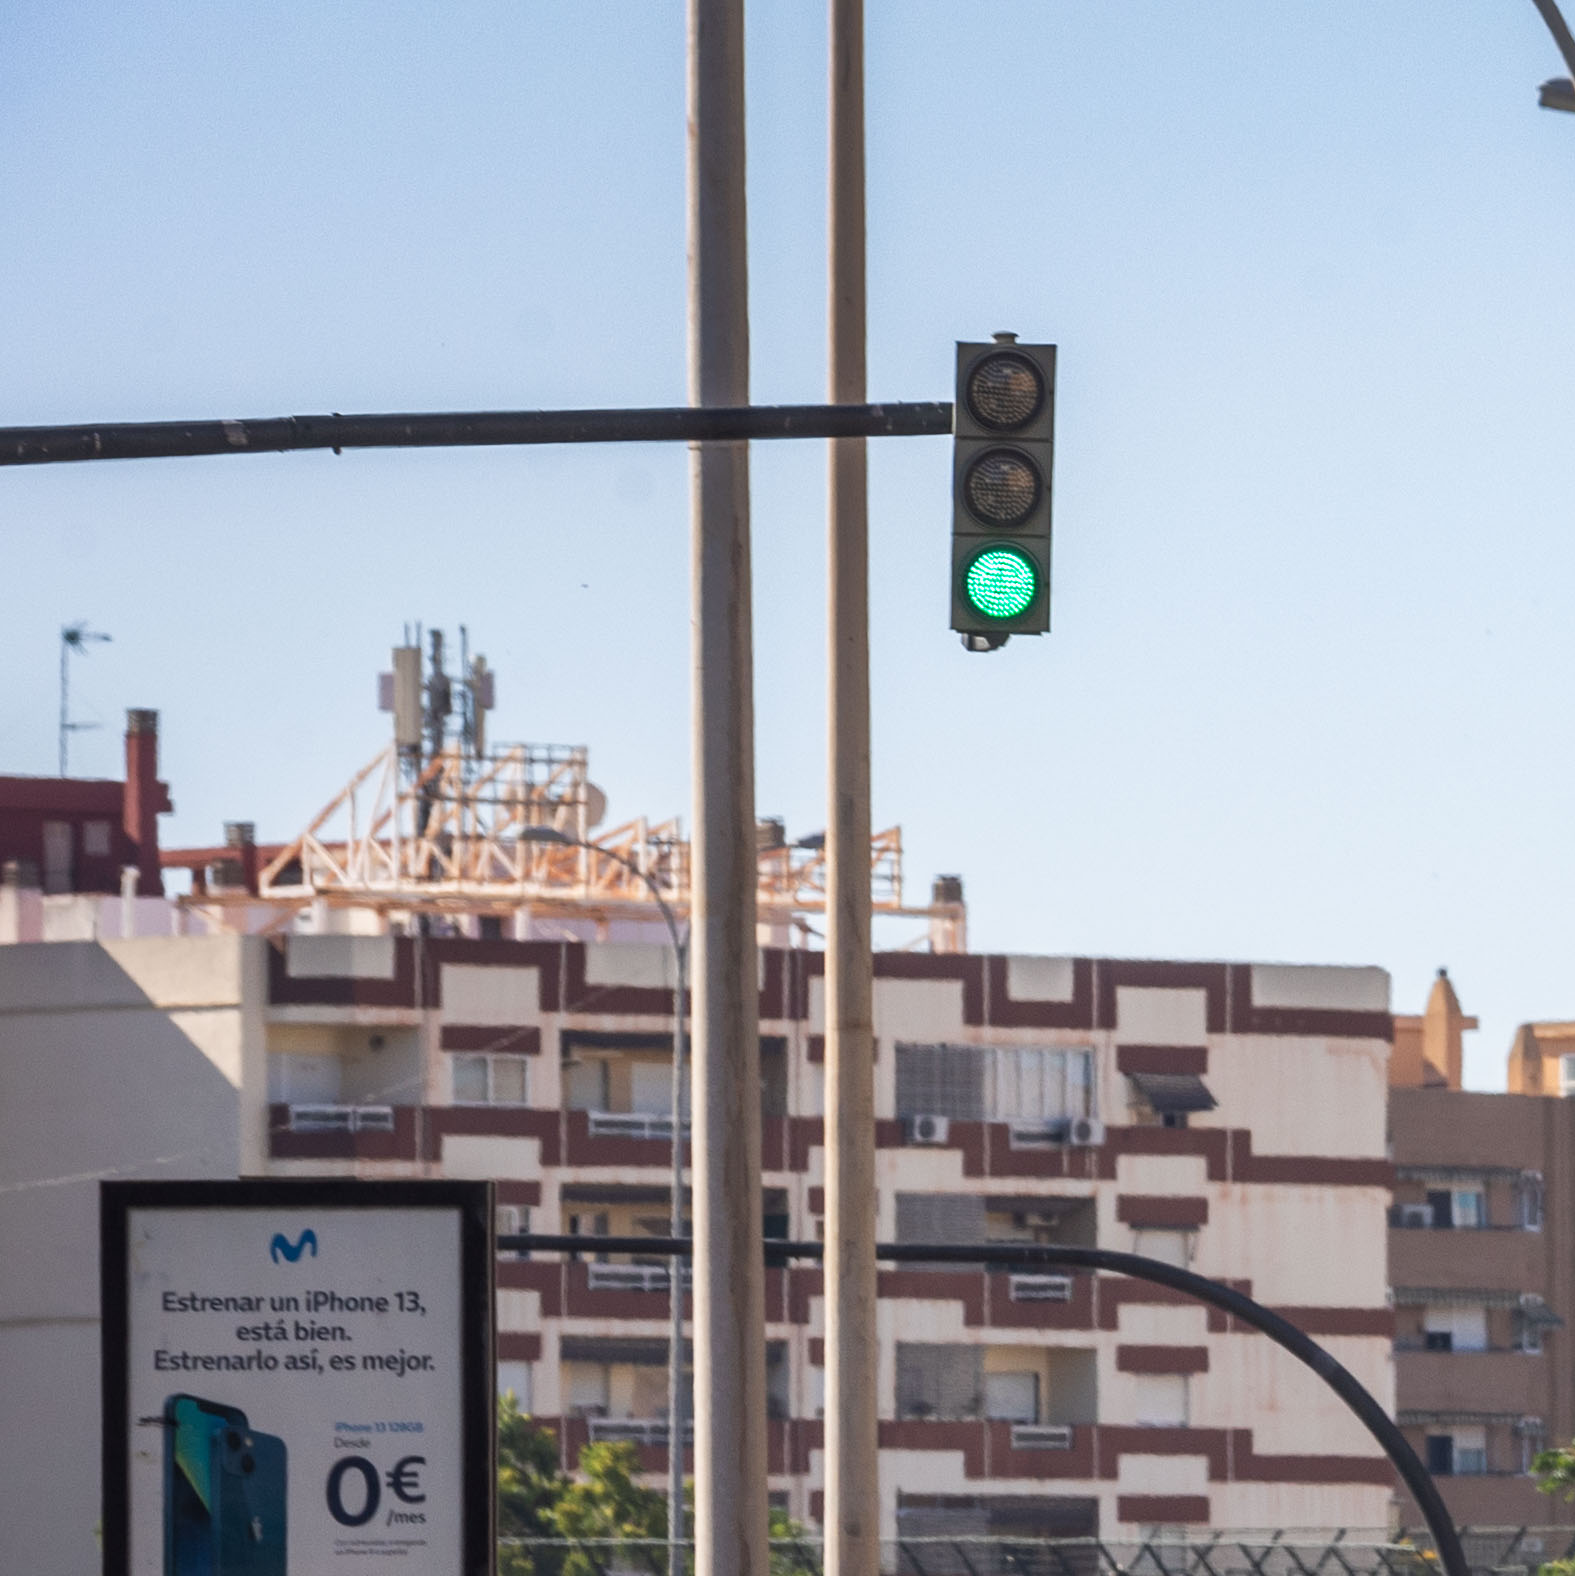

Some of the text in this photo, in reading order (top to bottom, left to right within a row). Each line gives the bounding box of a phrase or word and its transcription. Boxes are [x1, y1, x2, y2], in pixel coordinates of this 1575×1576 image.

[162, 1290, 426, 1316] Estrenar un iPhone 13,
[236, 1319, 351, 1341] está bien.
[154, 1348, 435, 1377] Estrenarlo así, es mejor.
[334, 1436, 371, 1448] Desde
[386, 1509, 427, 1528] /mes
